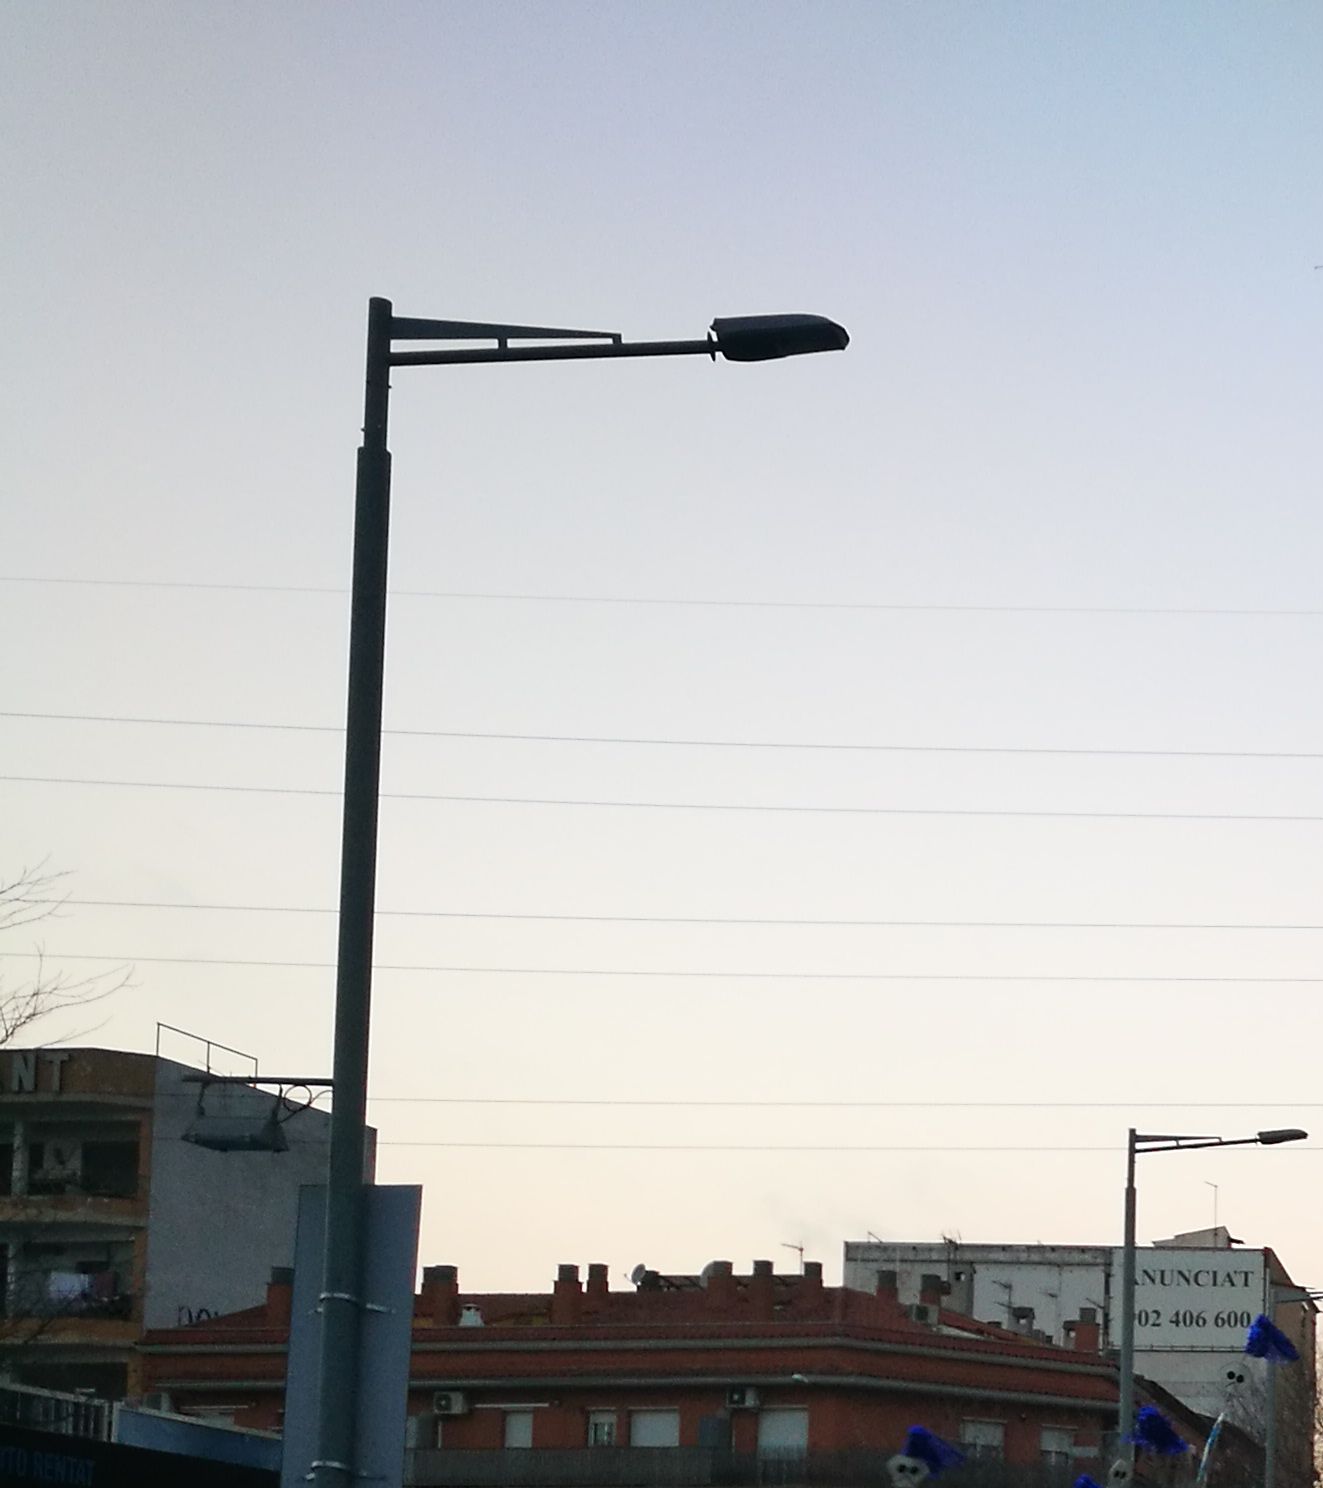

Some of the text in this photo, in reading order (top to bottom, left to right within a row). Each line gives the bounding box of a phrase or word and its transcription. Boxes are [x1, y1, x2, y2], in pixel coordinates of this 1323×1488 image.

[1134, 1310, 1251, 1328] 02 406 600
